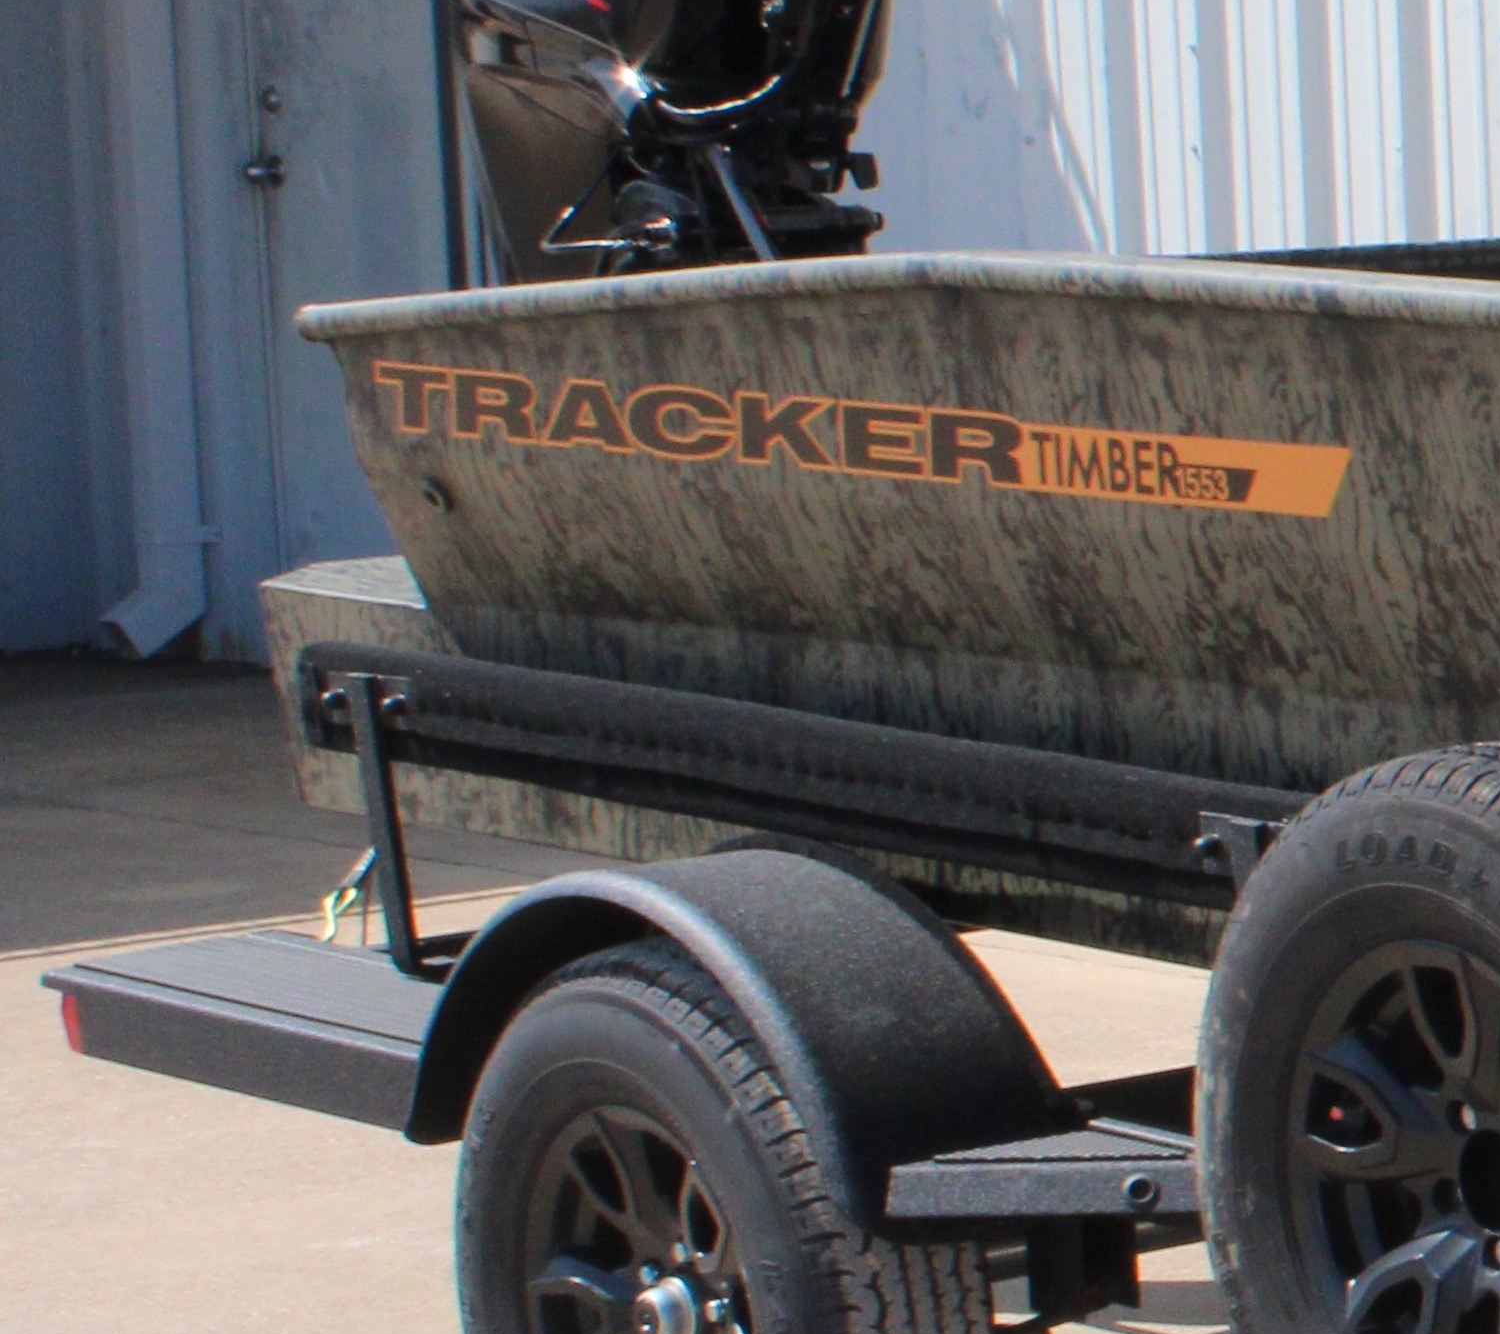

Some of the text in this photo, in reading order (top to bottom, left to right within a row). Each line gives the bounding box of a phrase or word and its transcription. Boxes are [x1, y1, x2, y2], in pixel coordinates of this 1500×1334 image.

[374, 361, 1230, 502] TRACKER TIMBER 1553
